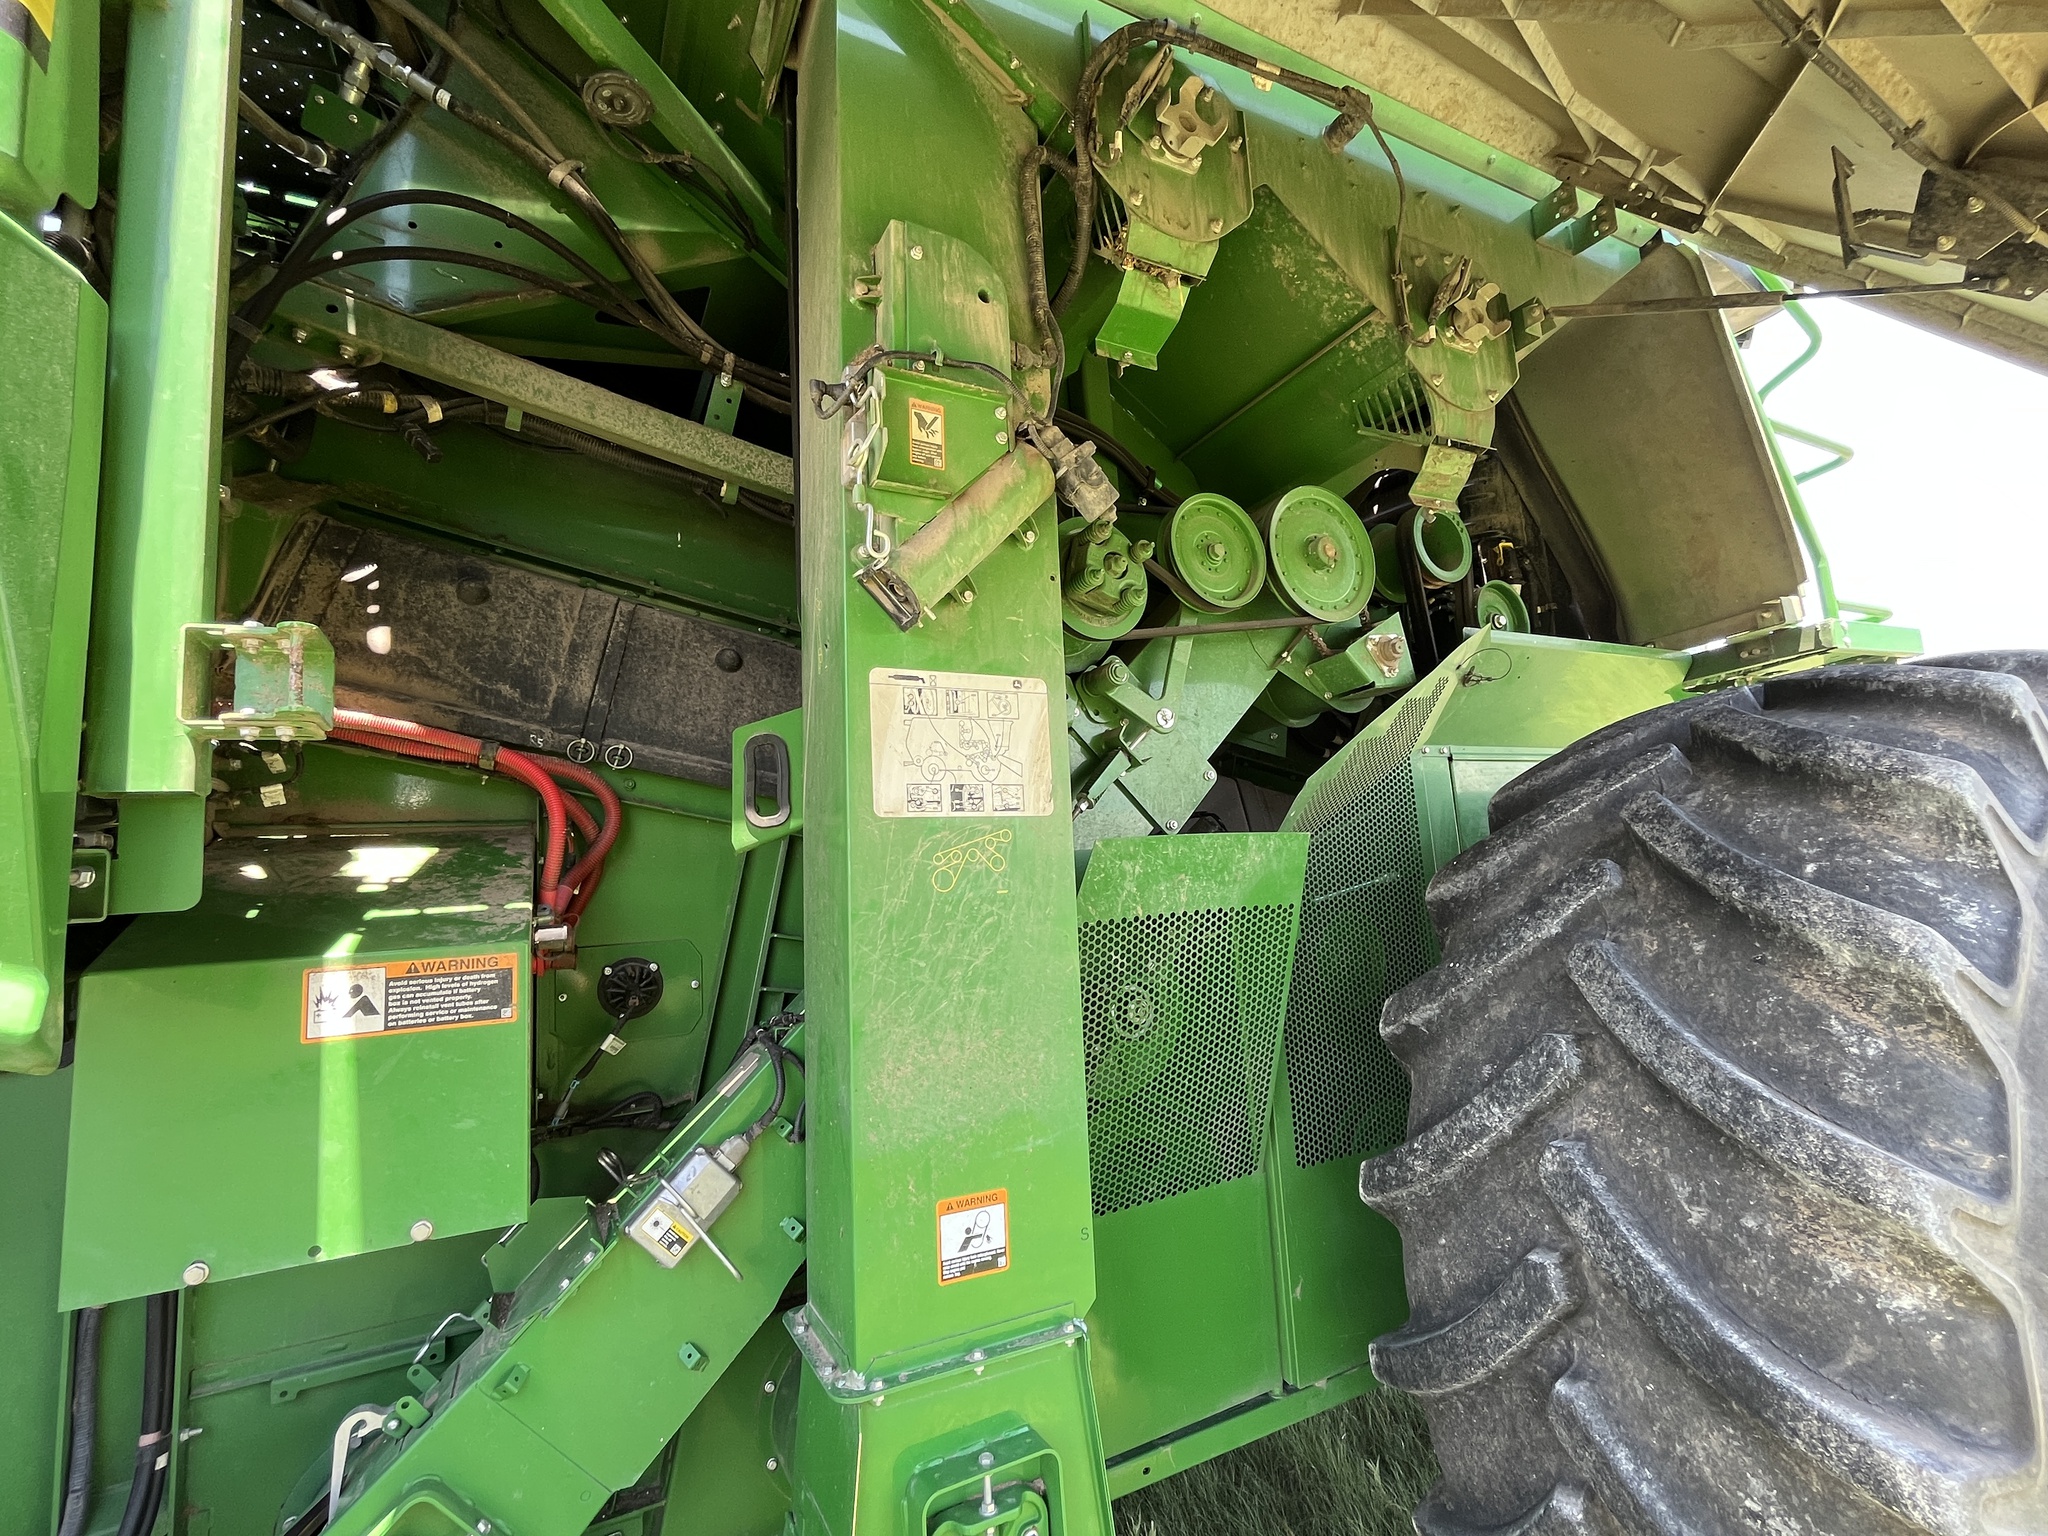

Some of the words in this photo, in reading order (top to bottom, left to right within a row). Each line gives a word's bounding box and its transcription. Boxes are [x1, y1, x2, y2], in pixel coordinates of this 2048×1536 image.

[421, 956, 499, 973] WARNING
[388, 986, 423, 994] explosion.
[469, 979, 499, 987] hydrogen
[409, 978, 433, 986] serious
[434, 976, 453, 984] injury
[415, 989, 452, 998] accumulate
[421, 996, 444, 1004] vented
[444, 994, 473, 1002] properly.
[388, 1006, 412, 1014] Always
[413, 1003, 440, 1011] reinstall
[388, 1012, 425, 1021] performing
[425, 1009, 449, 1017] service
[458, 1005, 498, 1013] maintenance
[398, 1018, 427, 1026] batteries
[955, 1193, 999, 1209] WARNING
